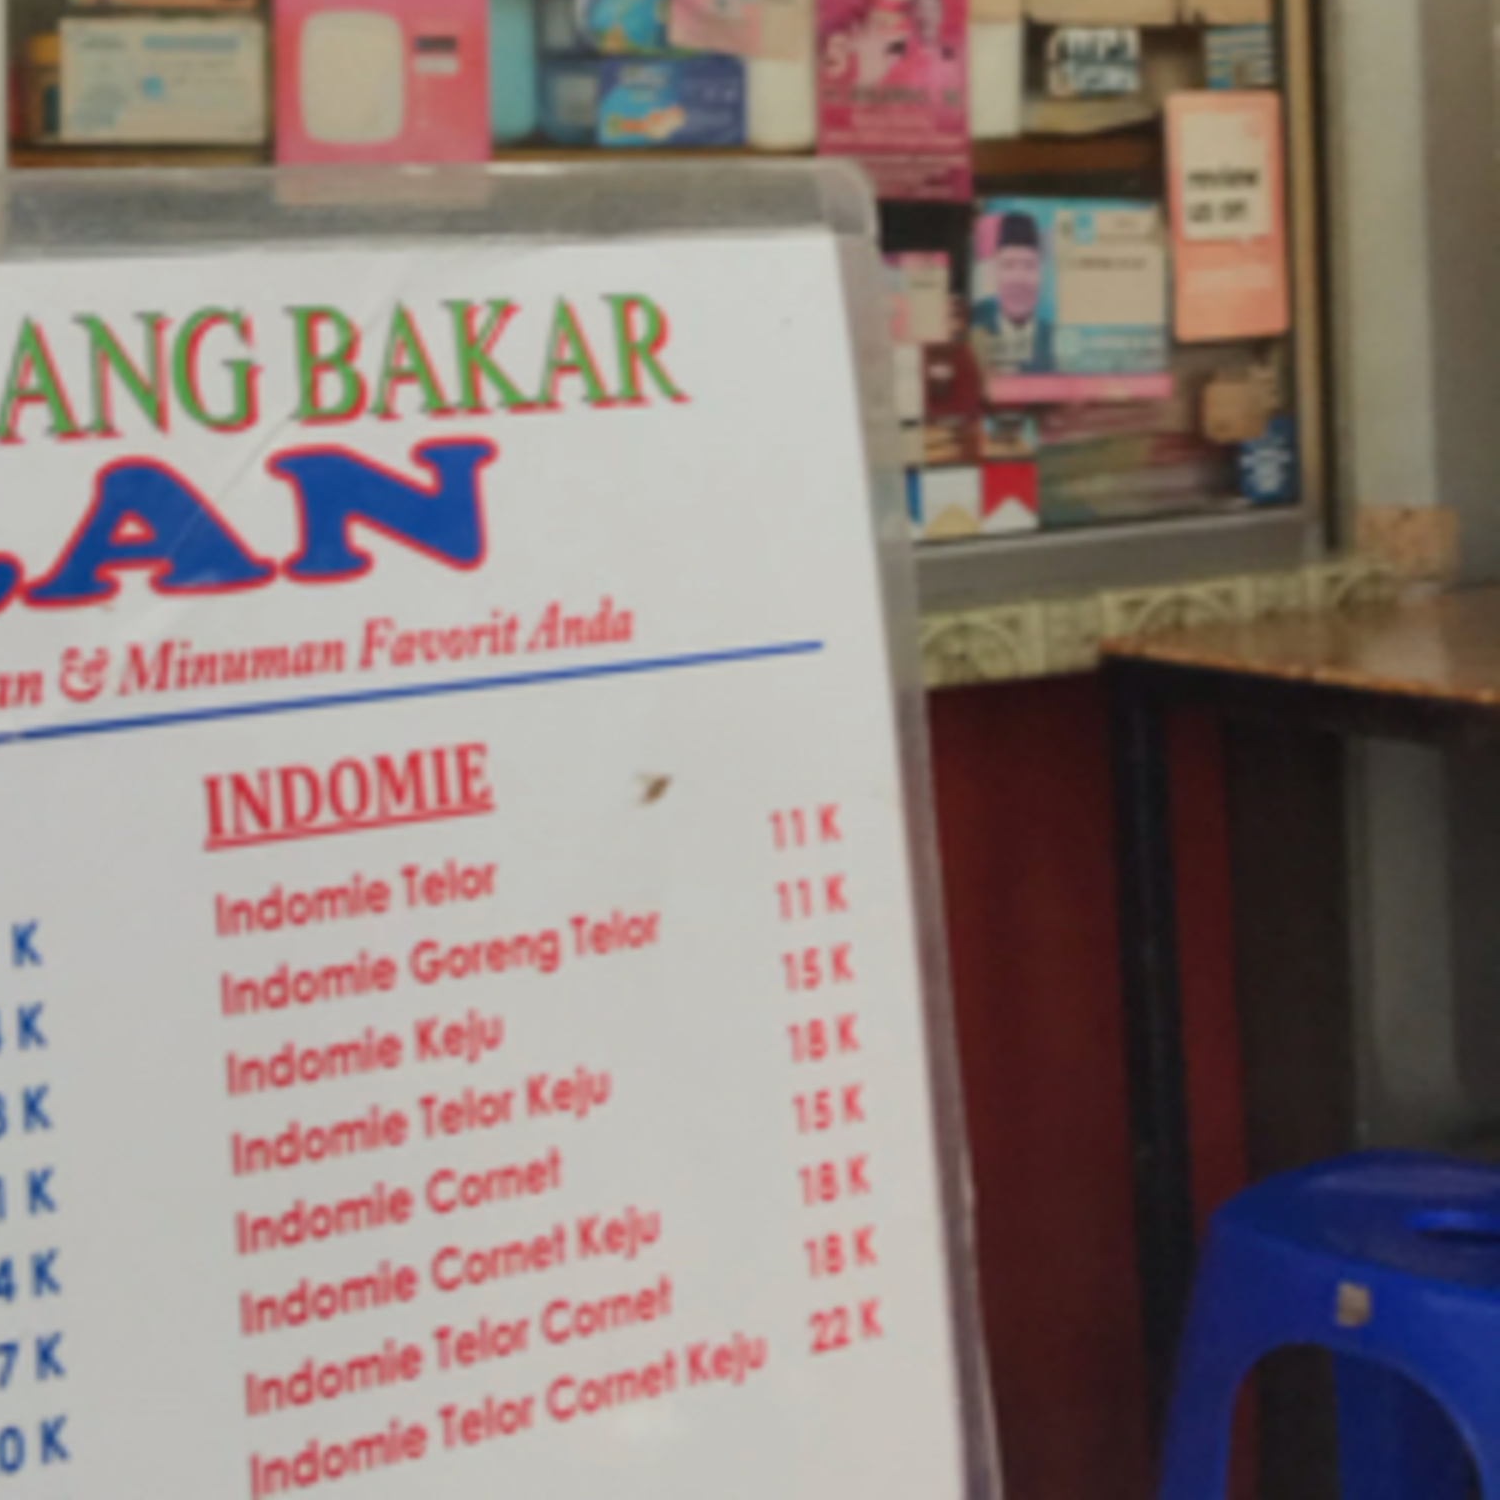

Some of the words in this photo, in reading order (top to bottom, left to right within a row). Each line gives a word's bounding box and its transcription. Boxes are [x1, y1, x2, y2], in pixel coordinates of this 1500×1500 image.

[286, 295, 692, 428] BAKAR
[57, 644, 111, 705] &
[117, 637, 348, 698] Minuman
[357, 613, 522, 671] Favorit
[524, 595, 636, 653] Anda
[202, 740, 490, 842] INDOMIE
[769, 808, 806, 850] 11
[819, 804, 842, 843] K
[215, 874, 392, 935] Indomie
[400, 860, 497, 906] Telor
[775, 878, 811, 921] 11
[825, 873, 848, 912] K
[12, 920, 42, 968] K
[221, 951, 398, 1014] Indomie
[409, 930, 563, 983] Goreng
[569, 910, 659, 954] Telor
[781, 947, 821, 991] 15
[831, 944, 855, 983] K
[18, 1002, 48, 1050] K
[226, 1028, 404, 1093] Indomie
[414, 1010, 504, 1062] Keju
[787, 1019, 828, 1062] 18
[837, 1013, 860, 1054] K
[23, 1084, 53, 1133] K
[231, 1106, 410, 1174] Indomie
[418, 1089, 515, 1136] Telor
[525, 1067, 611, 1117] Keju
[792, 1090, 833, 1134] 15
[841, 1084, 866, 1123] K
[28, 1167, 57, 1216] K
[235, 1183, 414, 1253] Indomie
[425, 1148, 563, 1213] Cornet
[798, 1162, 839, 1206] 18
[847, 1154, 871, 1195] K
[31, 1248, 62, 1296] K
[240, 1262, 419, 1333] Indomie
[431, 1225, 568, 1290] Cornet
[576, 1207, 661, 1258] Keju
[804, 1234, 845, 1279] 18
[853, 1225, 878, 1267] K
[245, 1341, 425, 1414] Indomie
[433, 1318, 531, 1368] Telor
[540, 1276, 672, 1343] Cornet
[809, 1307, 852, 1355] 22
[859, 1297, 884, 1339] K
[36, 1331, 66, 1382] K
[39, 1416, 70, 1465] K
[250, 1420, 428, 1500] Indomie
[438, 1397, 535, 1446] Telor
[546, 1351, 679, 1421] Cornet
[685, 1333, 768, 1384] Keju
